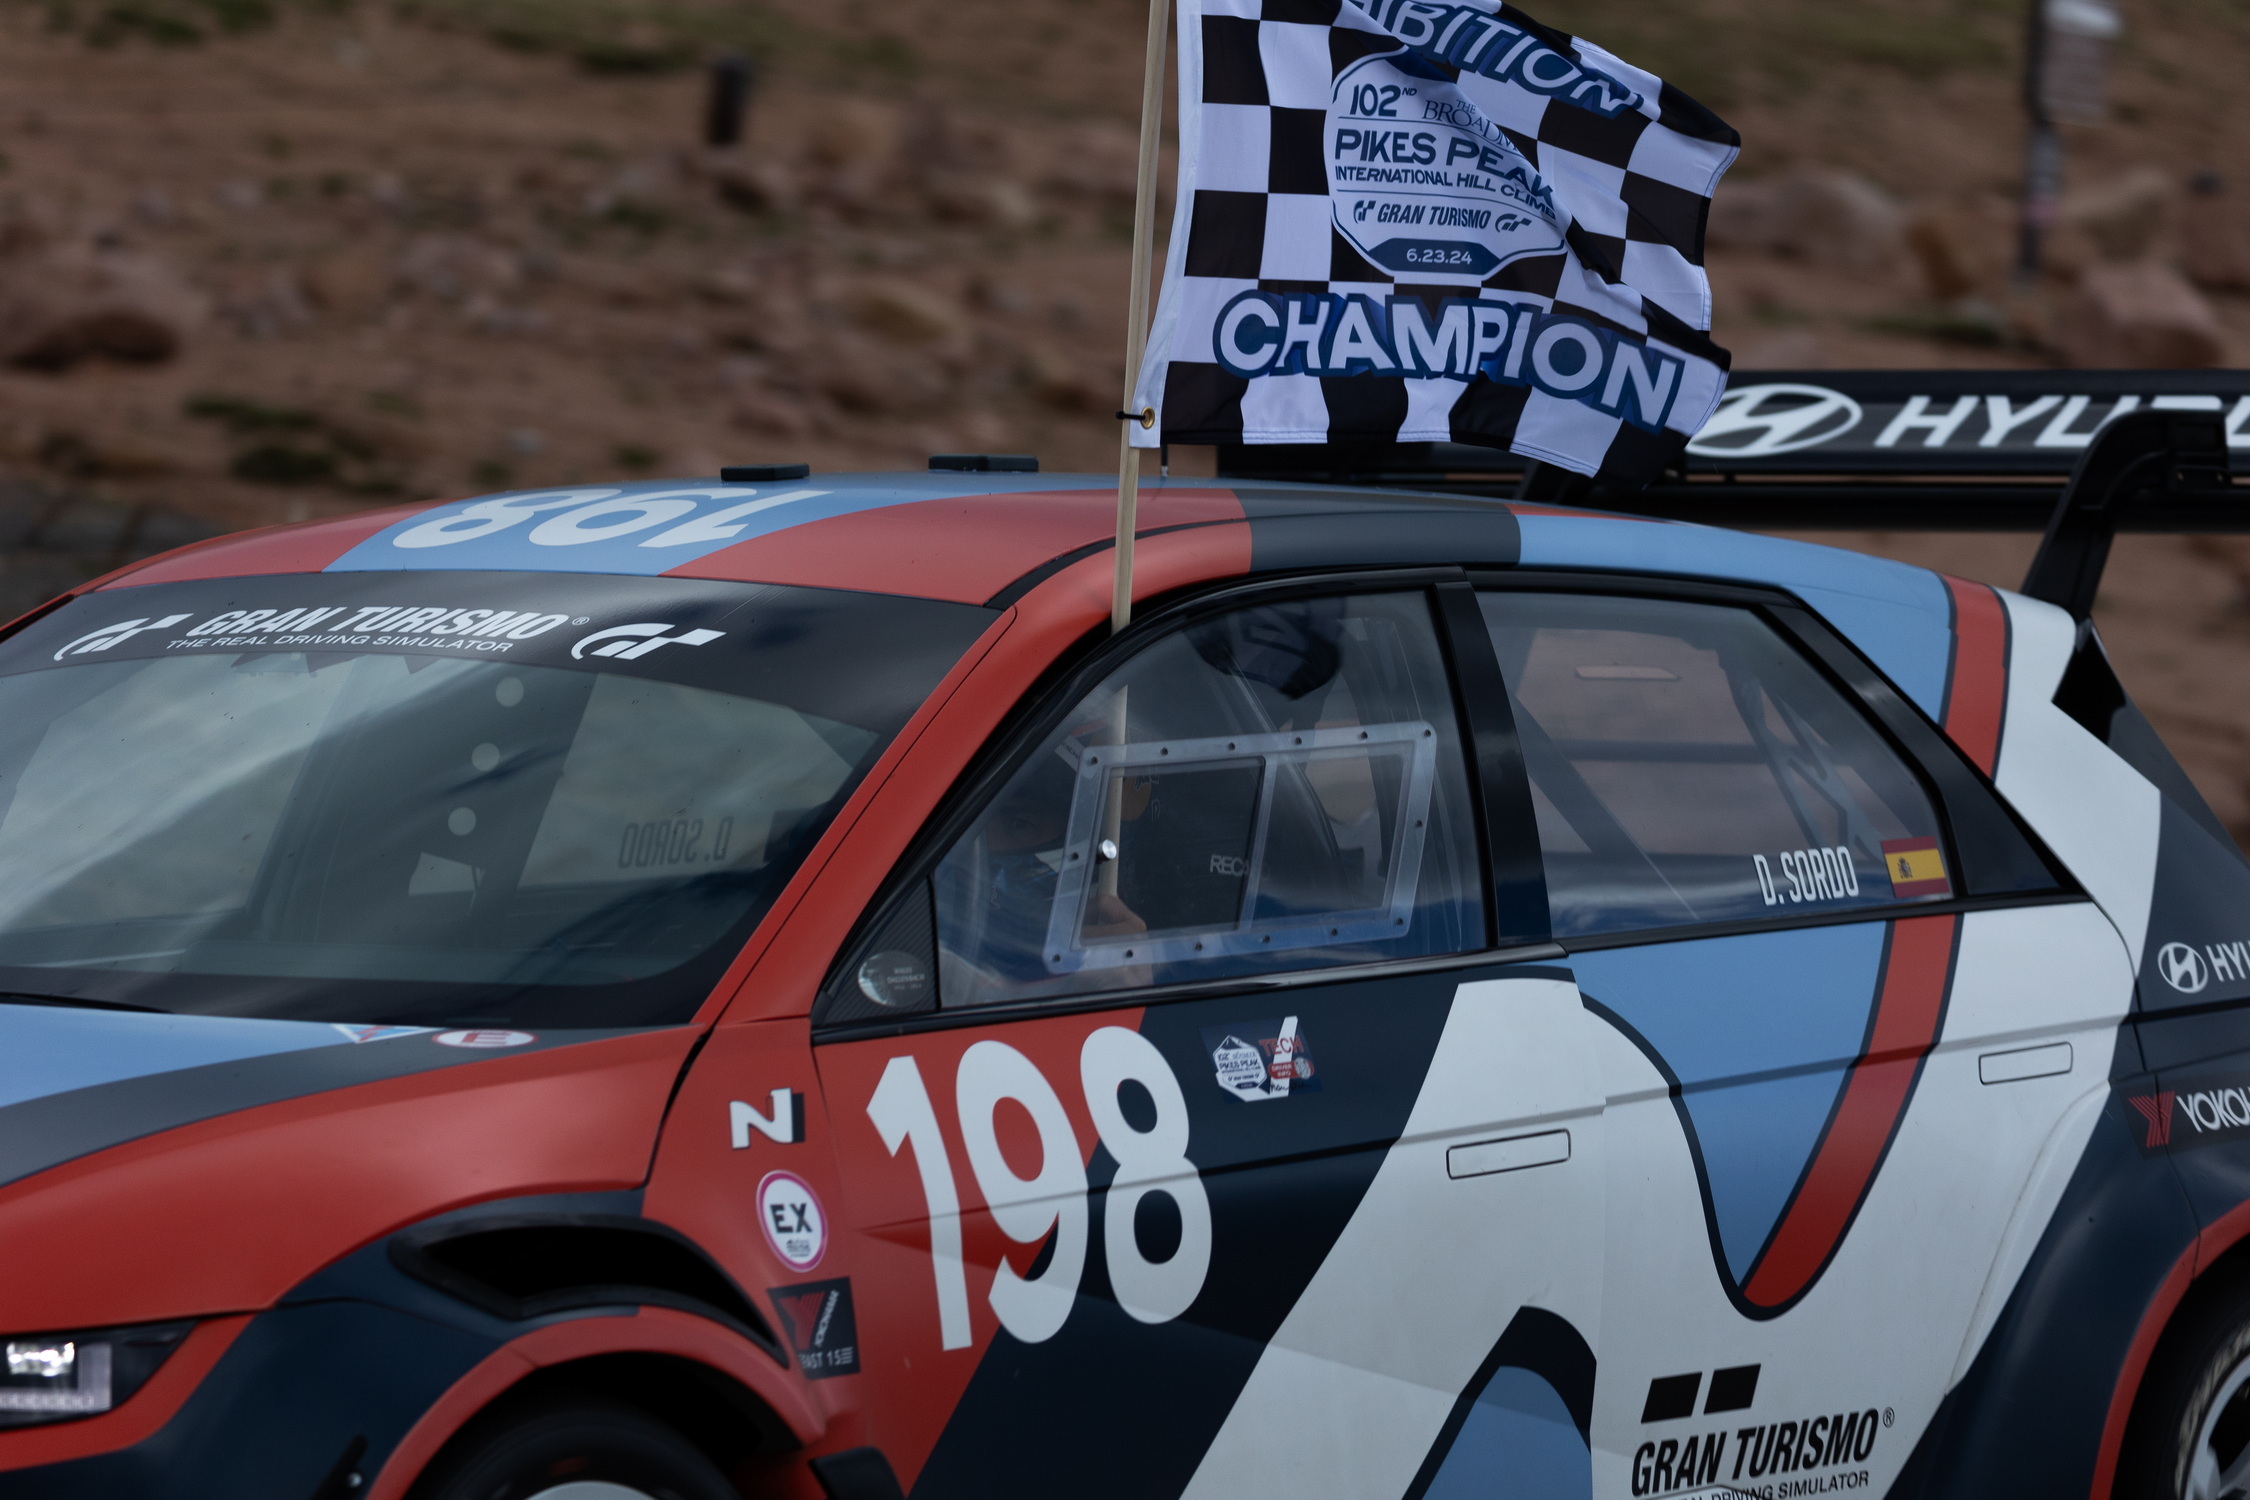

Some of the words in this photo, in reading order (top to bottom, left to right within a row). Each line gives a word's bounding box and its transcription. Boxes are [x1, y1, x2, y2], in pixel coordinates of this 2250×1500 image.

[1457, 100, 1476, 114] THE
[1335, 128, 1437, 165] PIKES
[1446, 137, 1555, 210] PEAK
[1335, 166, 1453, 186] INTERNATIONAL
[1456, 172, 1496, 192] HILL
[1500, 184, 1557, 220] CLIMB
[1377, 203, 1426, 225] GRAN
[1428, 205, 1492, 229] TURISMO
[1406, 248, 1472, 265] 6.23.24
[1217, 296, 1688, 428] CHAMPION
[185, 607, 347, 637] GRAN
[166, 638, 212, 650] THE
[211, 635, 269, 647] REAL
[273, 633, 371, 646] DRIVING
[372, 634, 514, 652] SIMULATOR
[1752, 853, 1785, 907] D.
[1781, 845, 1859, 904] SORDO
[1259, 1035, 1305, 1057] TECH
[866, 1025, 1212, 1352] 198
[770, 1203, 813, 1234] EX
[1631, 1431, 1727, 1497] GRAN
[1778, 1470, 1869, 1498] SIMULATOR
